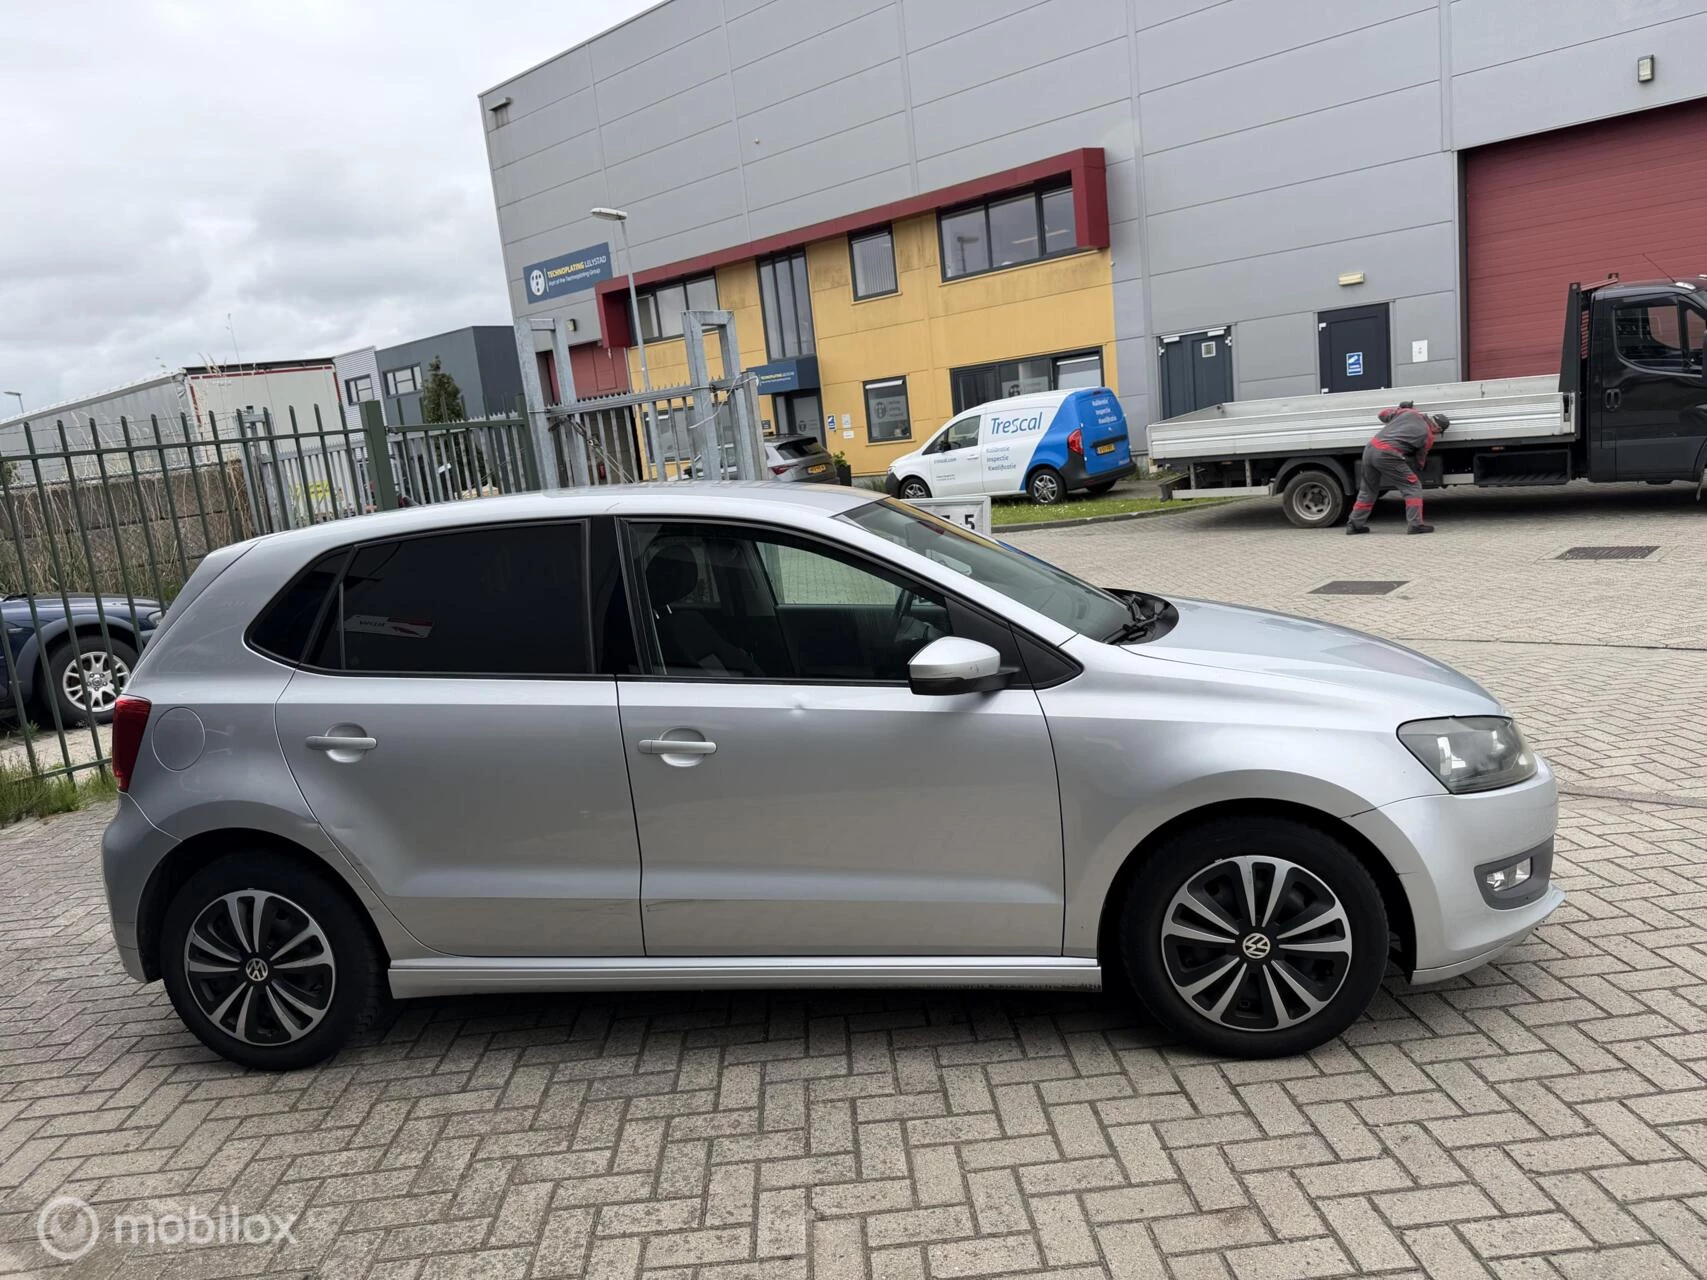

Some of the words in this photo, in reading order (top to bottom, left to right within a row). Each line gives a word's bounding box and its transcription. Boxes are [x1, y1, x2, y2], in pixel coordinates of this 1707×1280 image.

[547, 262, 585, 278] TECHNOPLATING
[585, 256, 607, 268] LELYSTAD
[991, 412, 1043, 435] Trescal
[965, 514, 975, 530] 5
